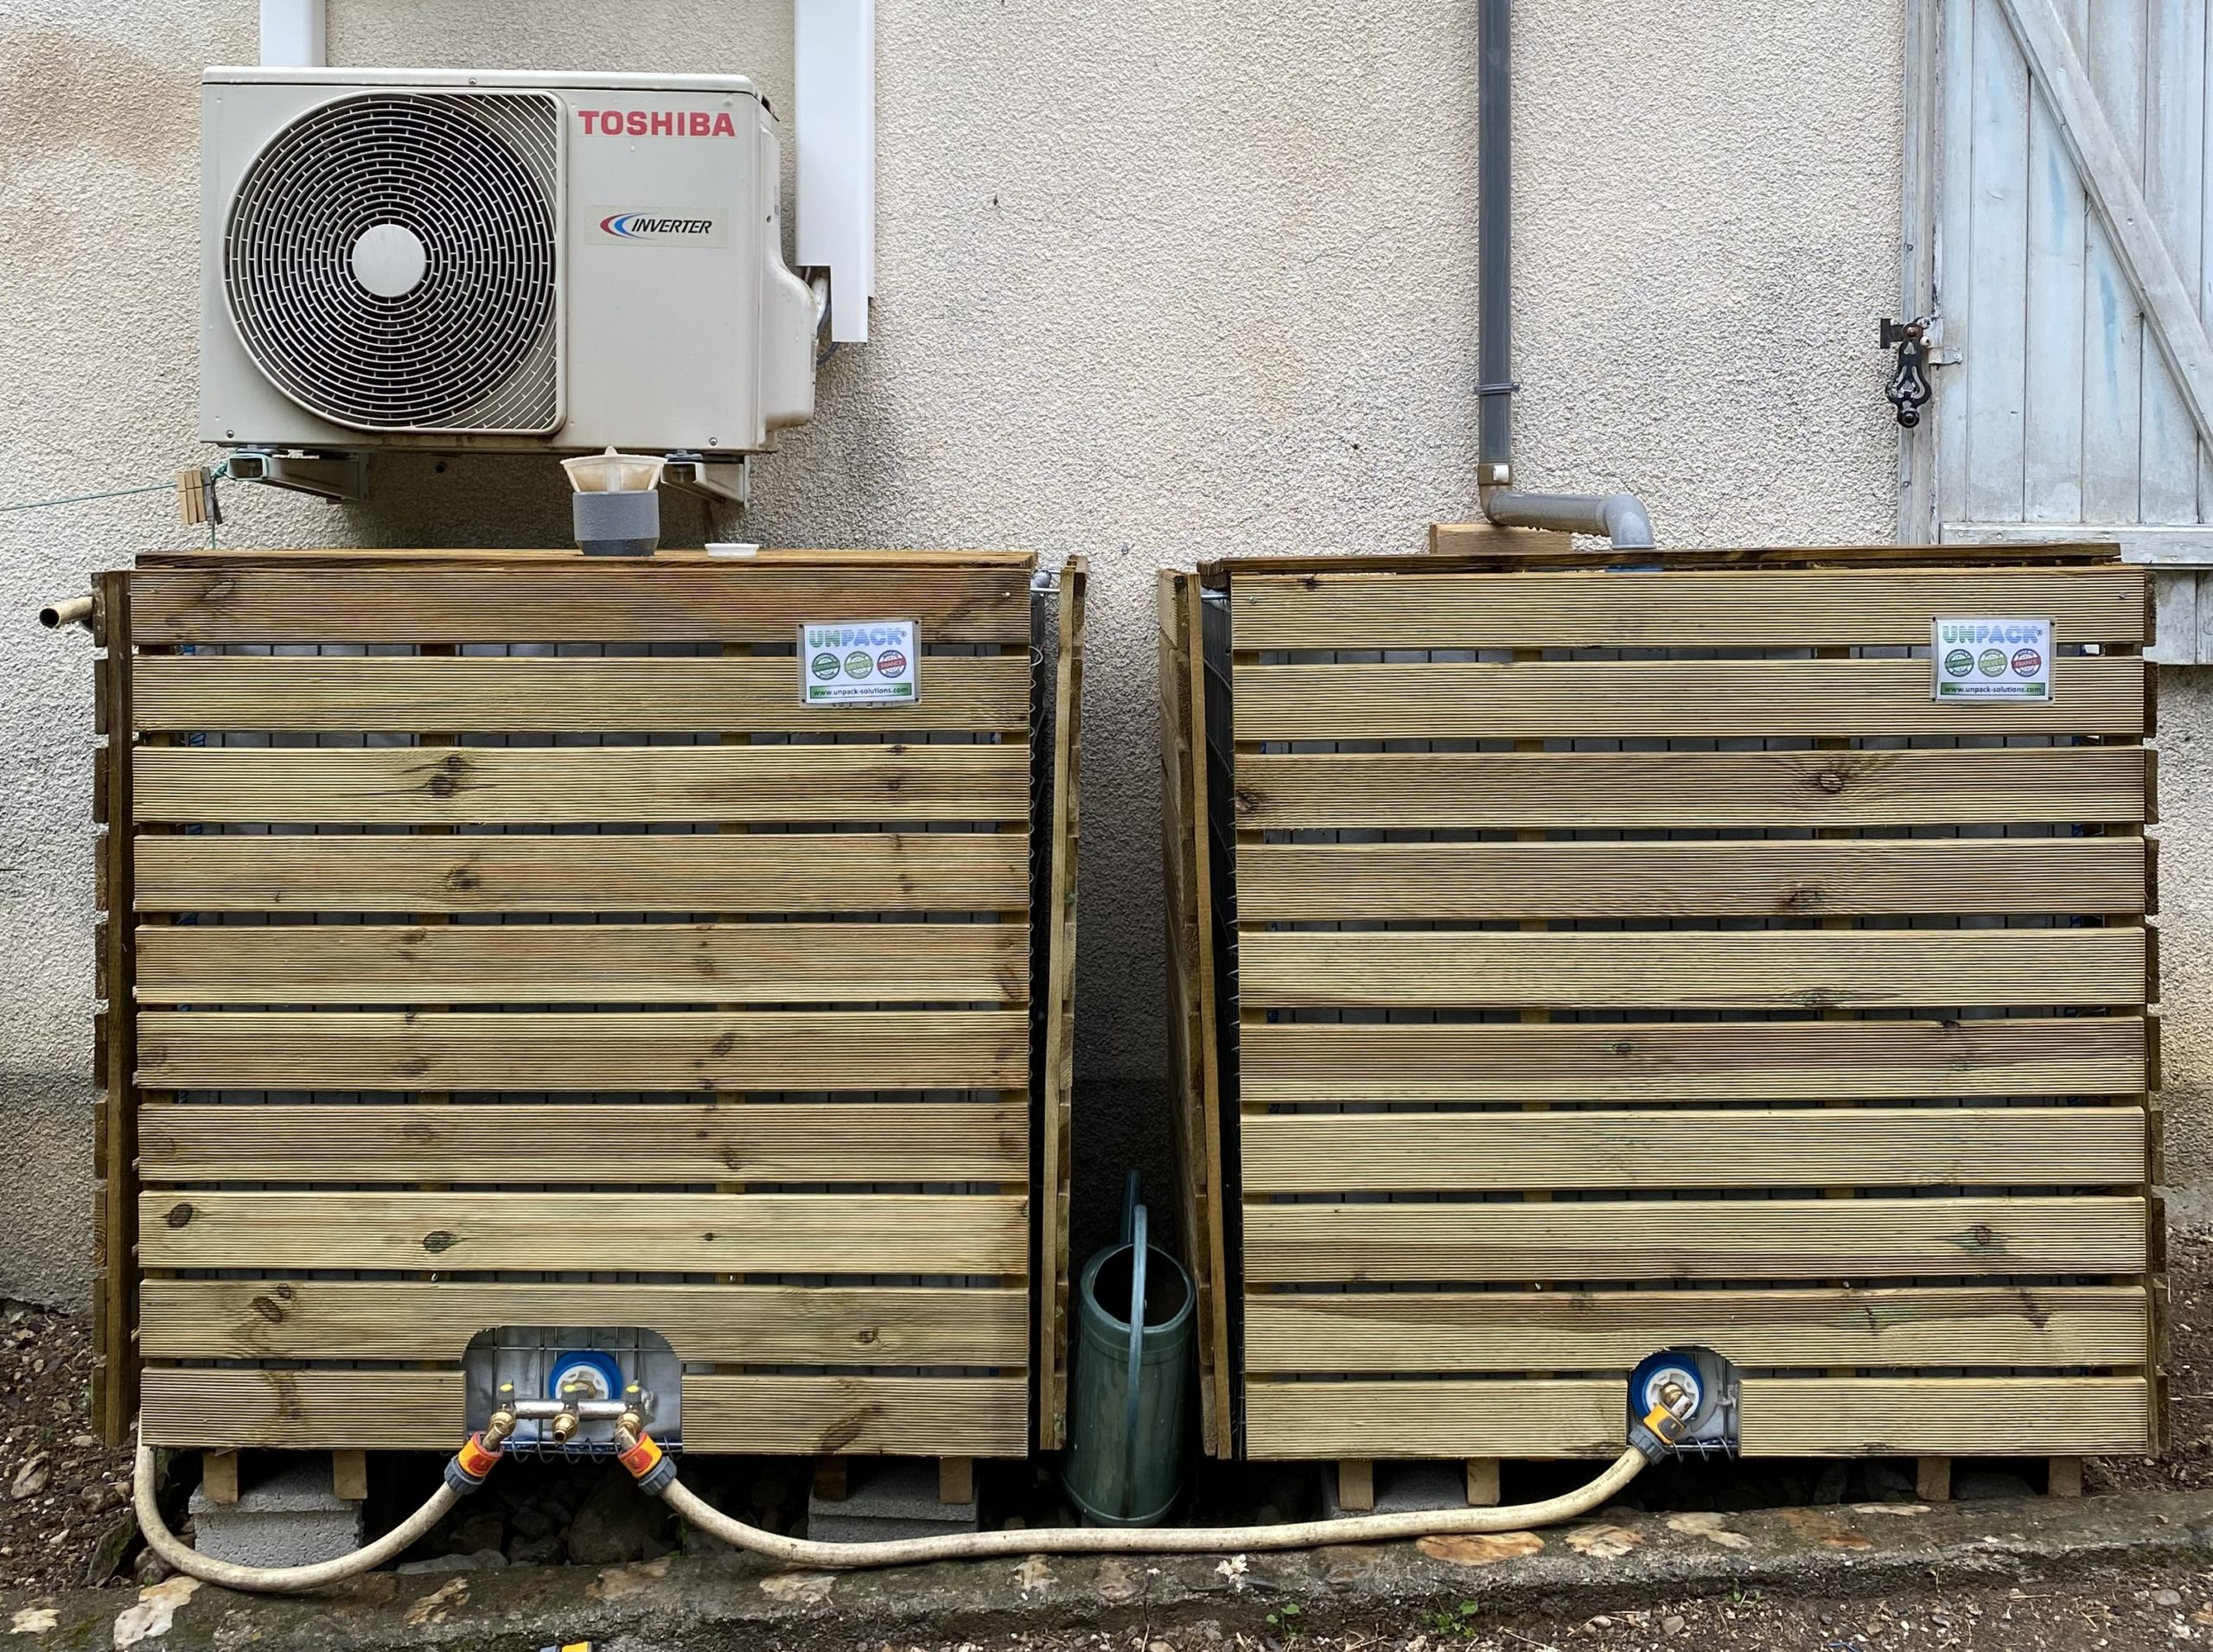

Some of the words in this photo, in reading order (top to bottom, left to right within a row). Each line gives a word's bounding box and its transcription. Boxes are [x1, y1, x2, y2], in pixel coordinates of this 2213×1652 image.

[577, 110, 736, 137] TOSHIBA
[631, 218, 712, 234] INVERTER
[813, 686, 909, 696] www.unpack-solutions.com
[1945, 685, 2041, 693] www.unpack-solutions.com
